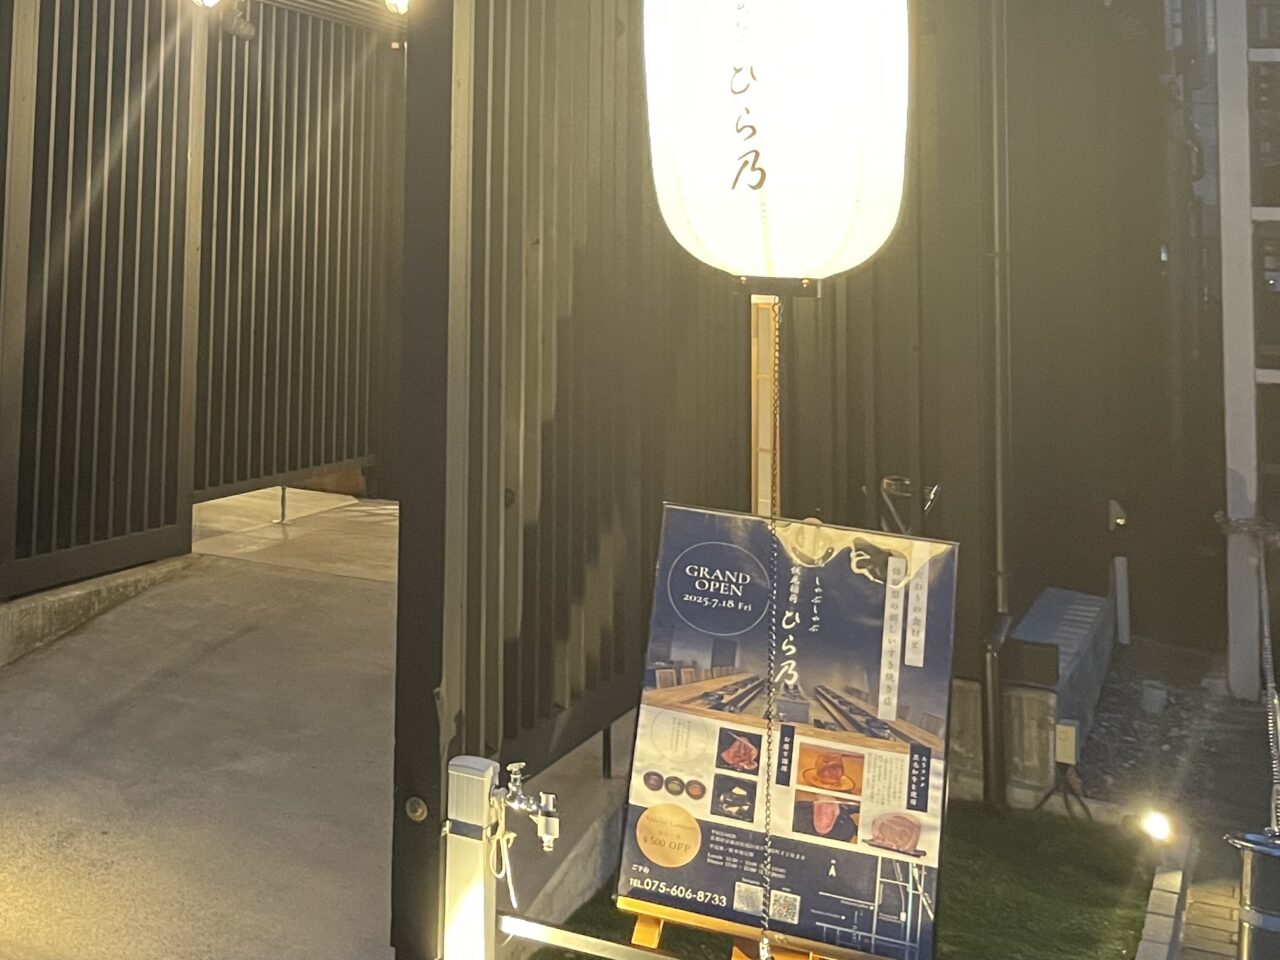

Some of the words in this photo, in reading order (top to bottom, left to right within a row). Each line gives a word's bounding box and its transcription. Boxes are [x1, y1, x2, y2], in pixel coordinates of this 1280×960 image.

[685, 564, 751, 585] GRAND
[695, 579, 743, 597] OPEN
[683, 593, 735, 609] 2025.7.18
[738, 601, 752, 612] Fri
